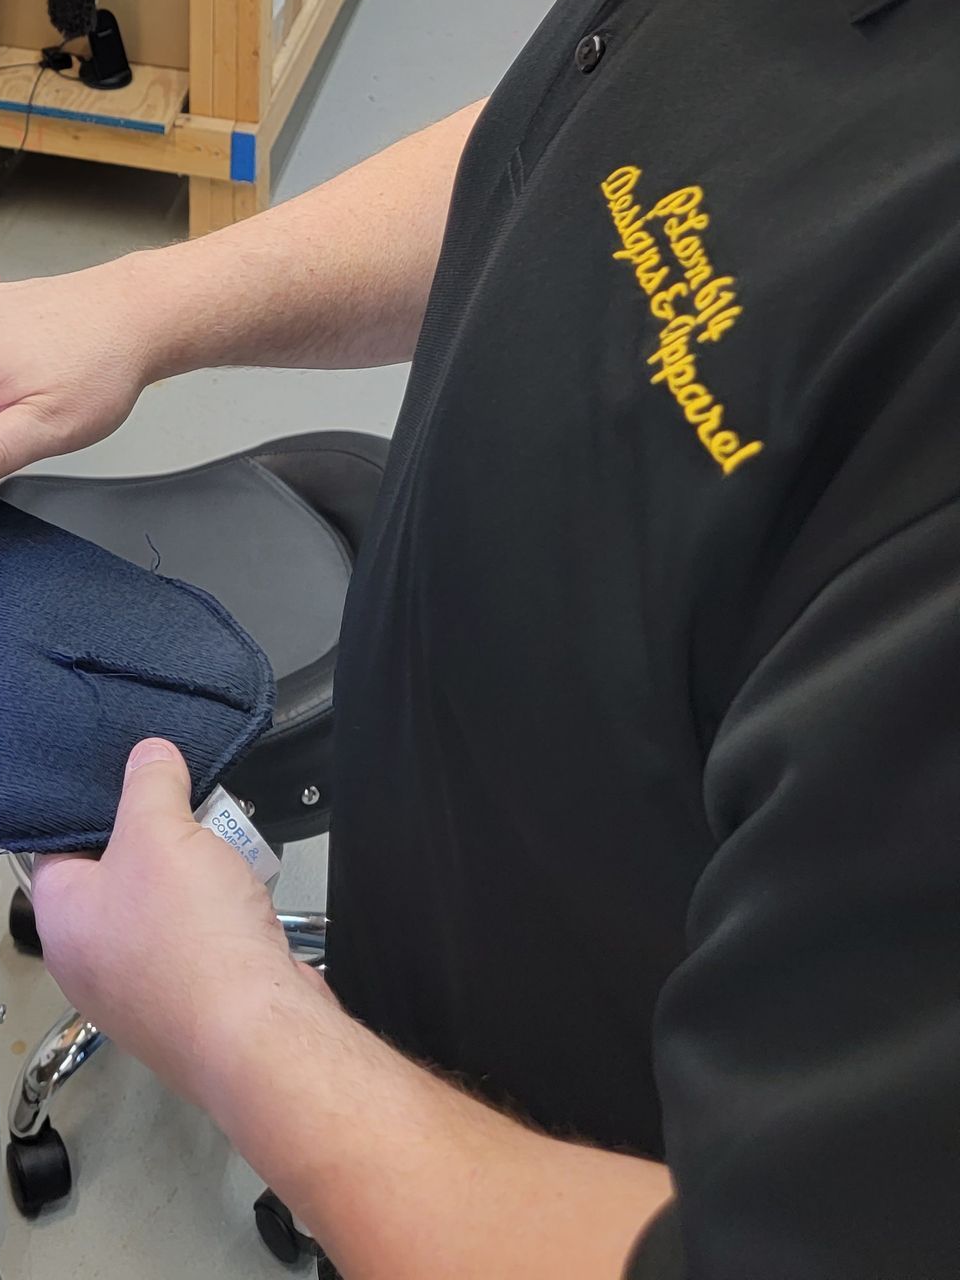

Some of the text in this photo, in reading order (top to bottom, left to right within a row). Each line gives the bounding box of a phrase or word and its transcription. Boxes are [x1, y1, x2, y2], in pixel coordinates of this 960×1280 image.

[601, 166, 763, 475] Designs & Apparel
[212, 817, 254, 865] COMP
[219, 809, 253, 847] PORT
